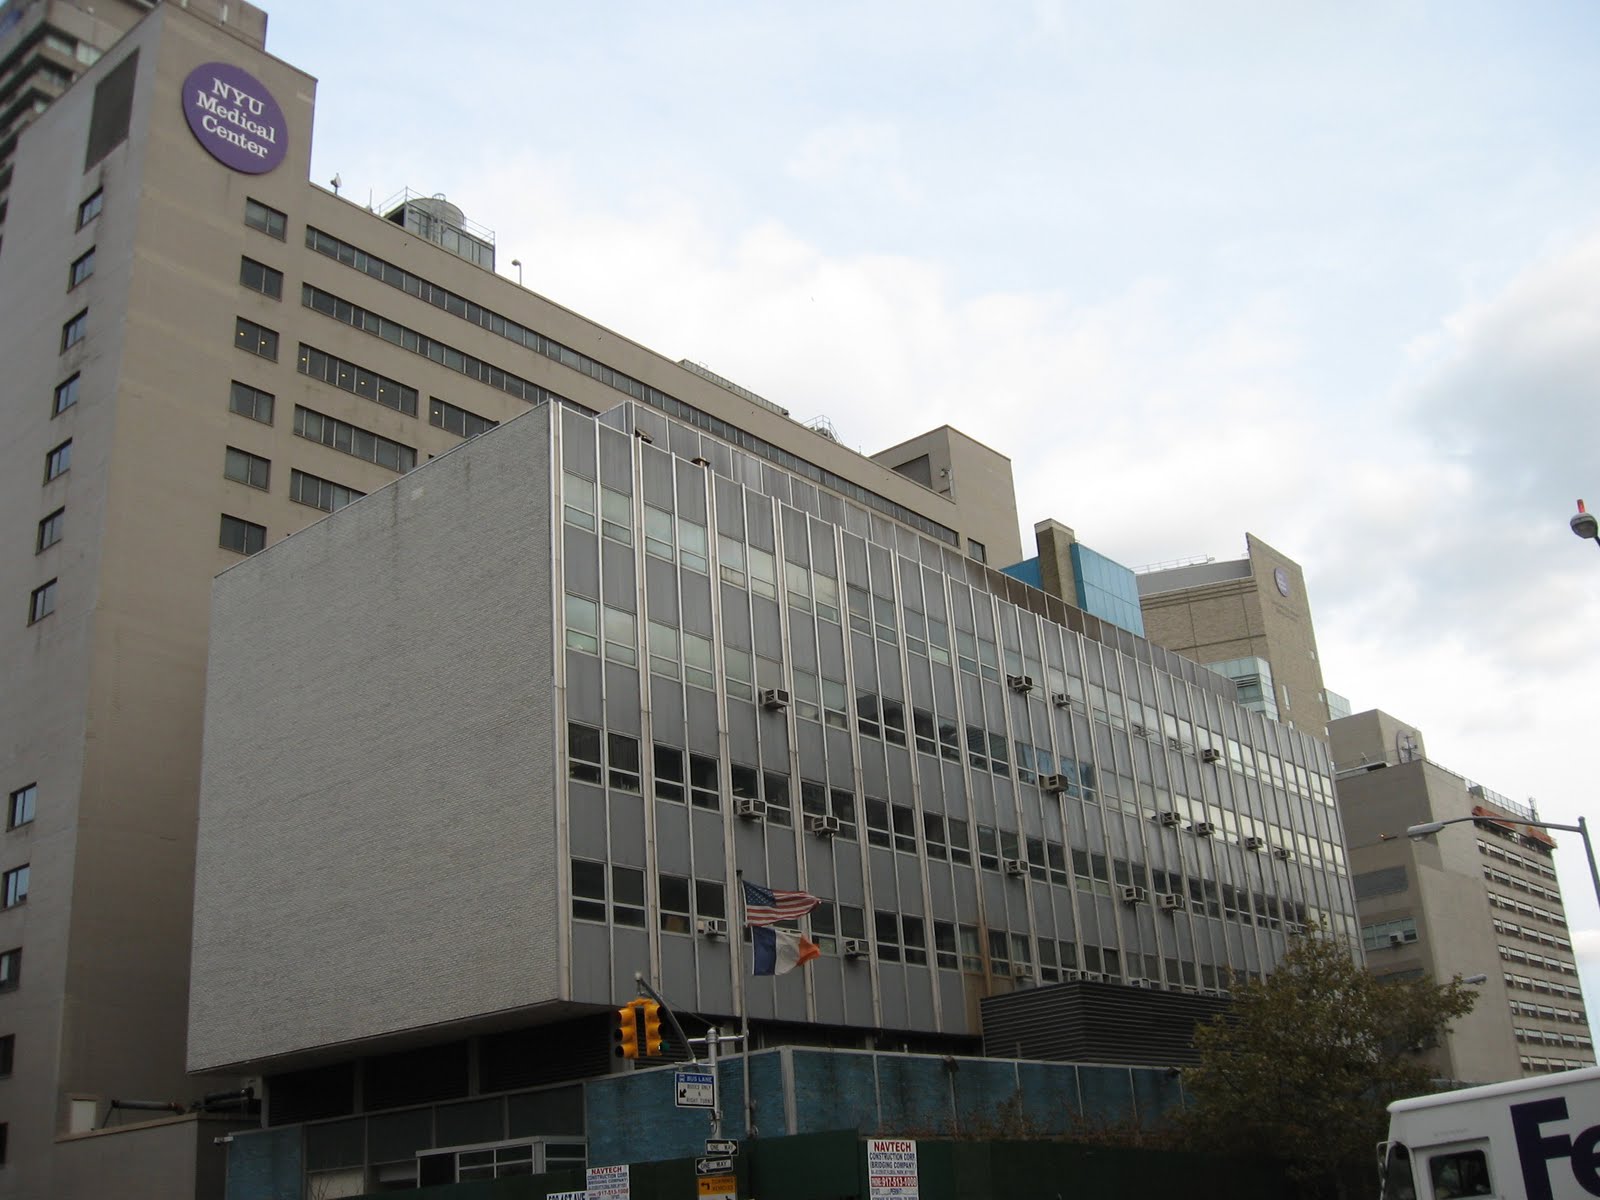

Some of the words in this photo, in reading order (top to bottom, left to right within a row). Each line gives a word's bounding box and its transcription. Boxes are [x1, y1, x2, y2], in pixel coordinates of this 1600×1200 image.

[212, 77, 265, 115] NYU
[196, 90, 276, 143] Medical
[202, 114, 268, 158] Center
[869, 1152, 903, 1160] CONSTRUCTION
[873, 1141, 912, 1152] NAVTECH
[591, 1166, 622, 1175] NAVTECH
